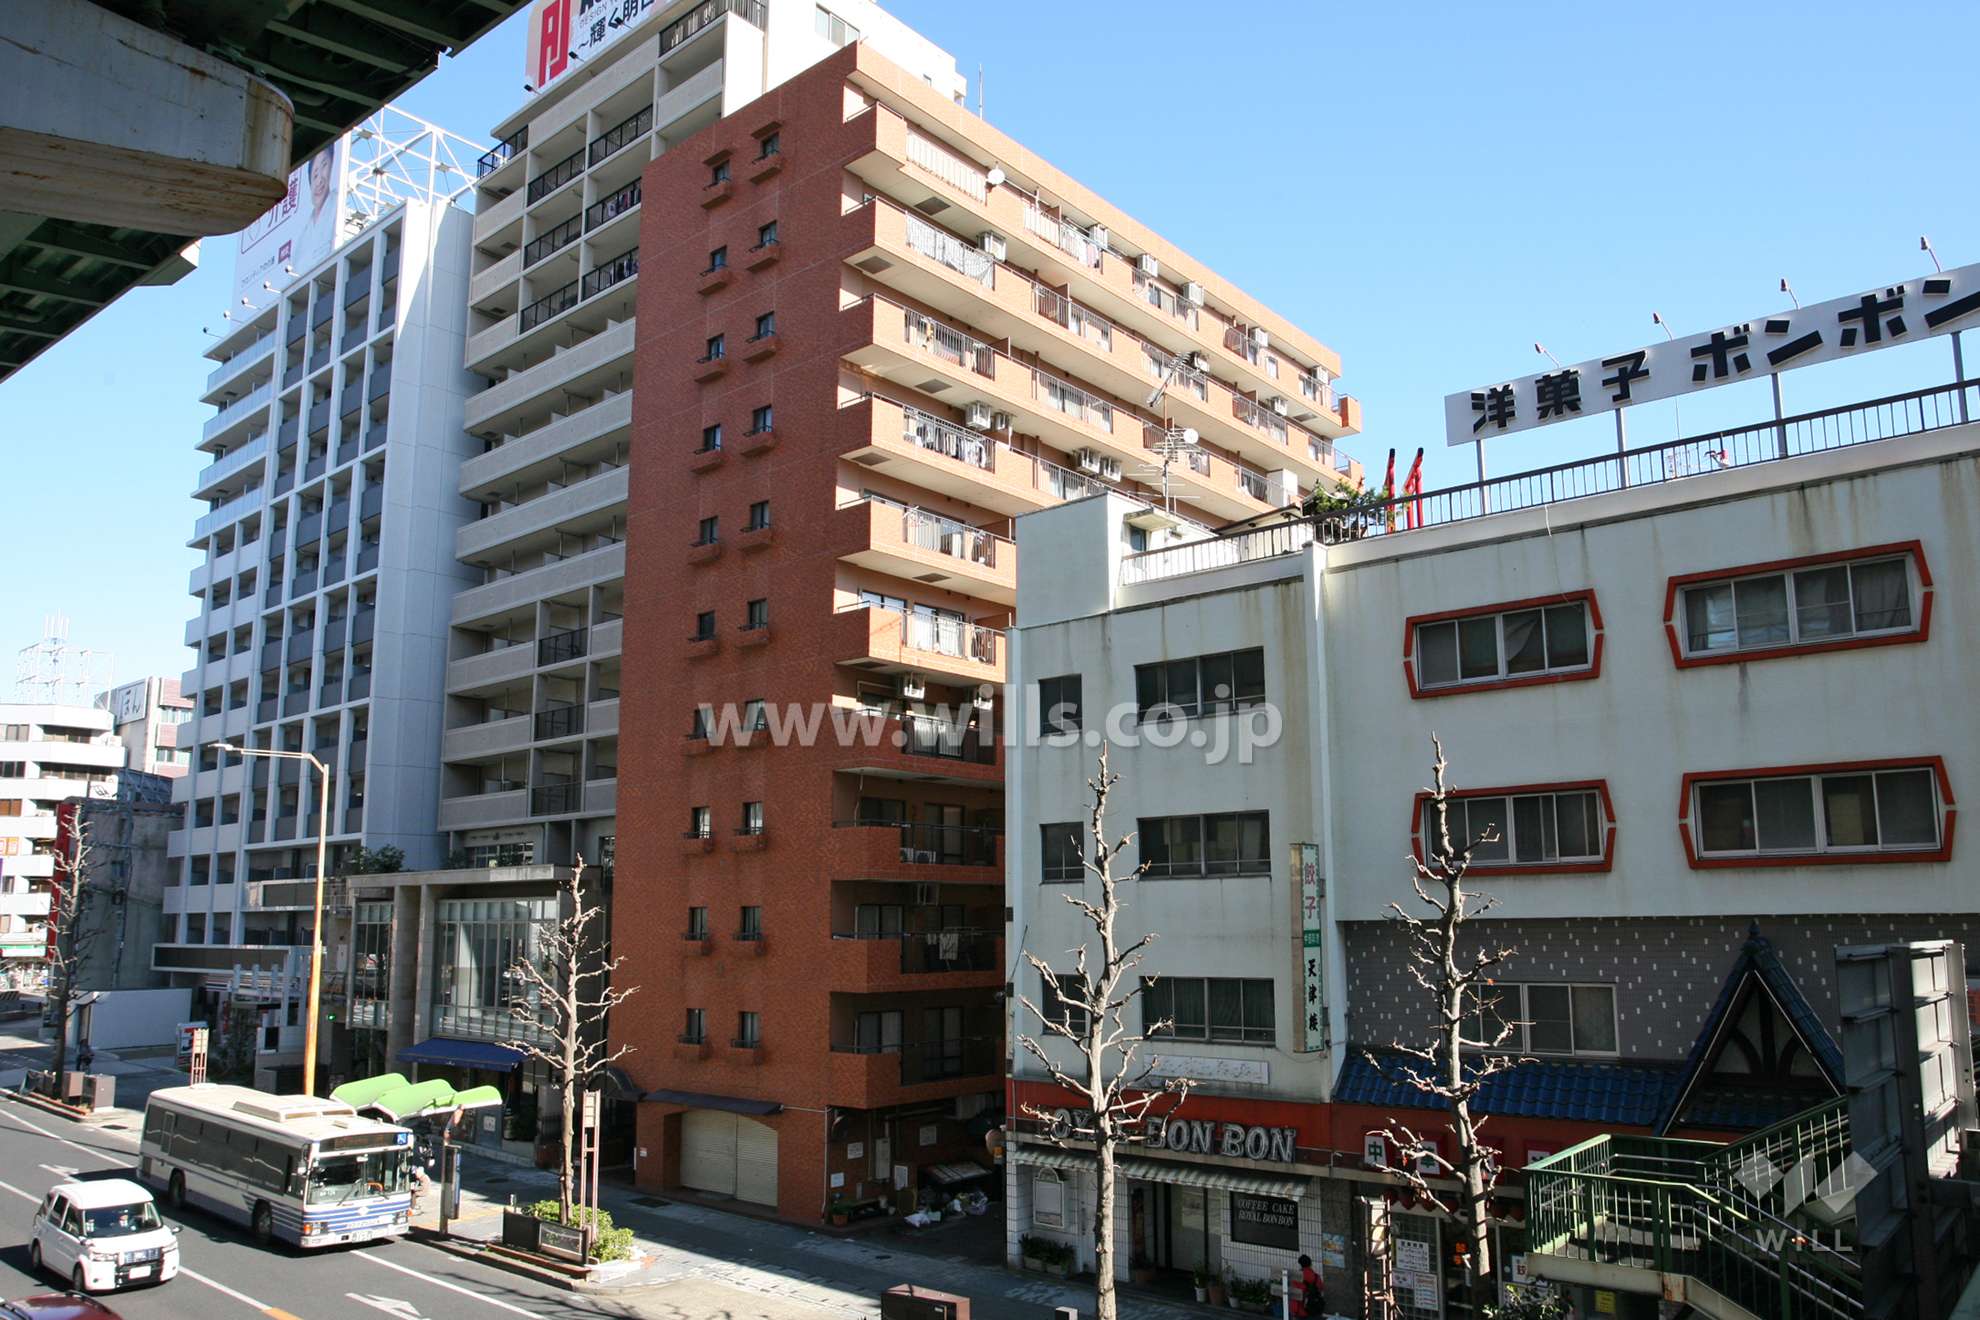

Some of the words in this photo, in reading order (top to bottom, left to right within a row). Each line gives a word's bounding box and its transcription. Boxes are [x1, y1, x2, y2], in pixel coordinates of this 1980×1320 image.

[1471, 349, 1650, 434] 洋菓子
[1691, 278, 1980, 383] ボンボン
[1146, 1116, 1216, 1155] BON
[1221, 1123, 1297, 1163] BON
[1272, 1203, 1296, 1215] CAKE
